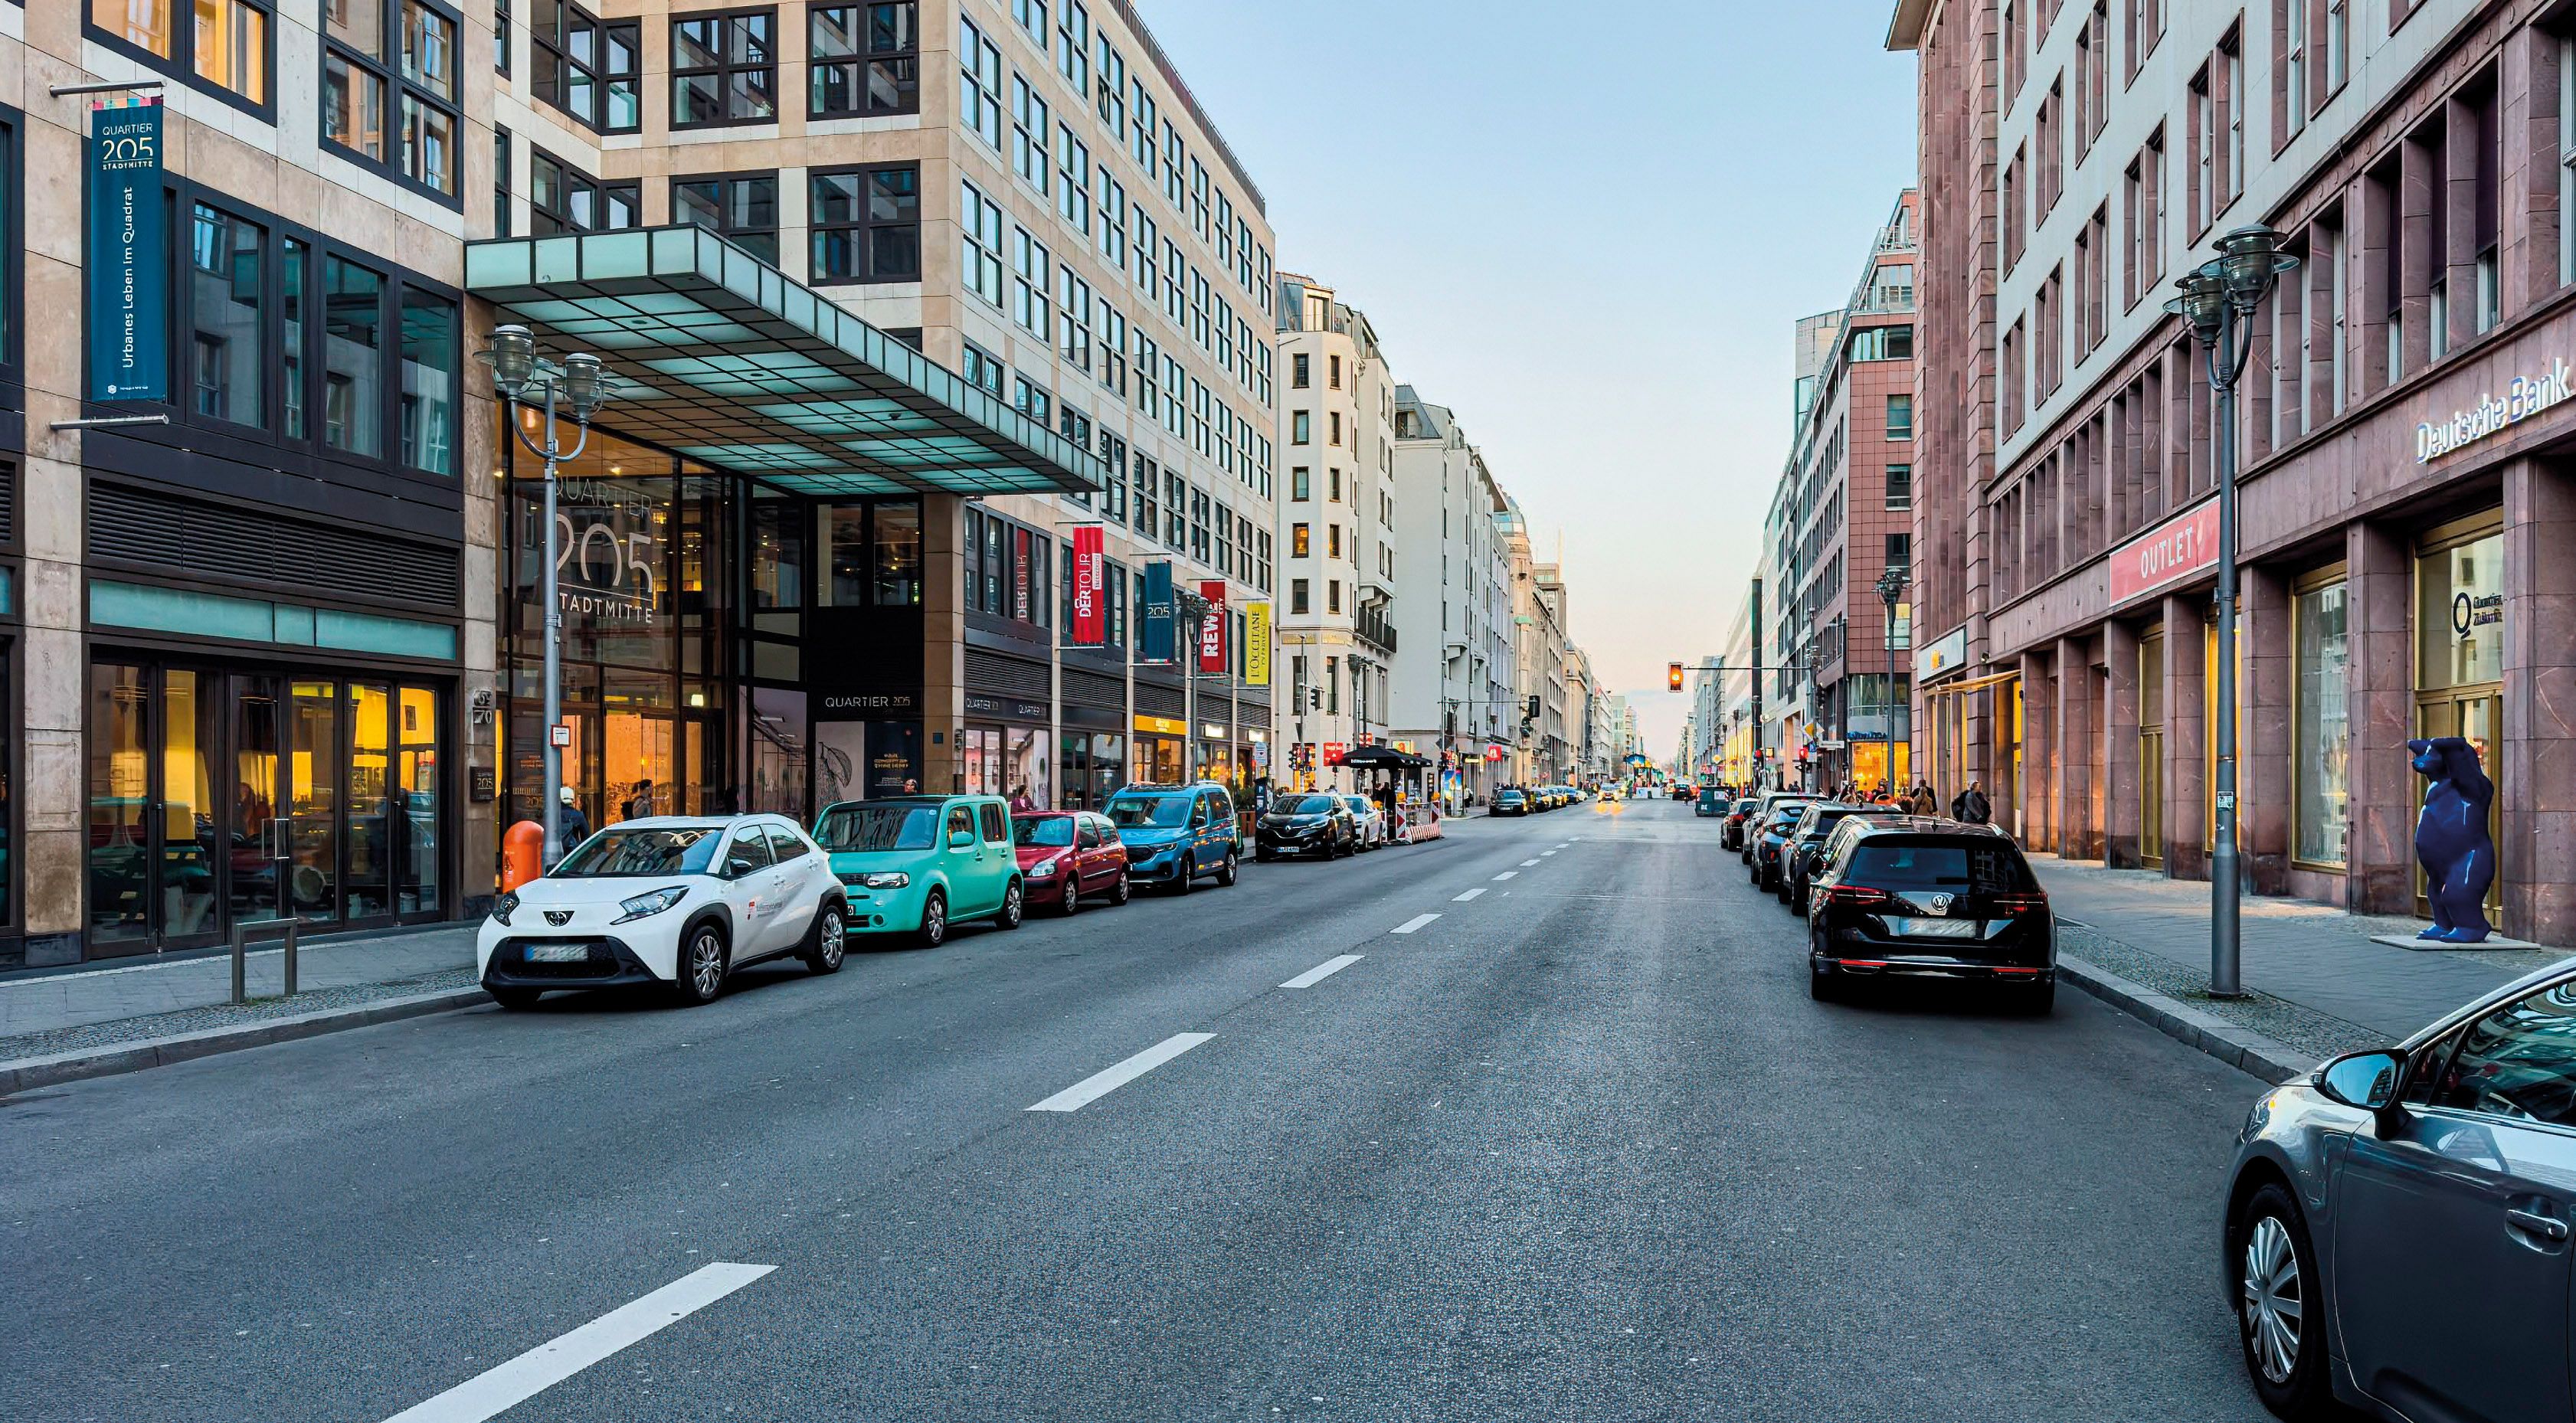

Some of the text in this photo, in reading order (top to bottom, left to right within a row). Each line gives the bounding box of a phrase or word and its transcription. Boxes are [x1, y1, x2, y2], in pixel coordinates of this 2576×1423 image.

[103, 123, 152, 135] QUARTIER
[103, 137, 153, 160] 205
[123, 187, 135, 244] Quadrat
[123, 269, 133, 309] Leben
[123, 313, 133, 368] Urbanes
[2416, 357, 2571, 465] Deutsche Bank
[557, 513, 652, 594] 205
[2141, 526, 2192, 579] OUTLET
[559, 592, 653, 624] TADTMITTE
[1079, 554, 1092, 617] DERTOUR
[1203, 602, 1218, 657] REWE
[2453, 592, 2472, 640] Q
[825, 696, 889, 708] QUARTIER
